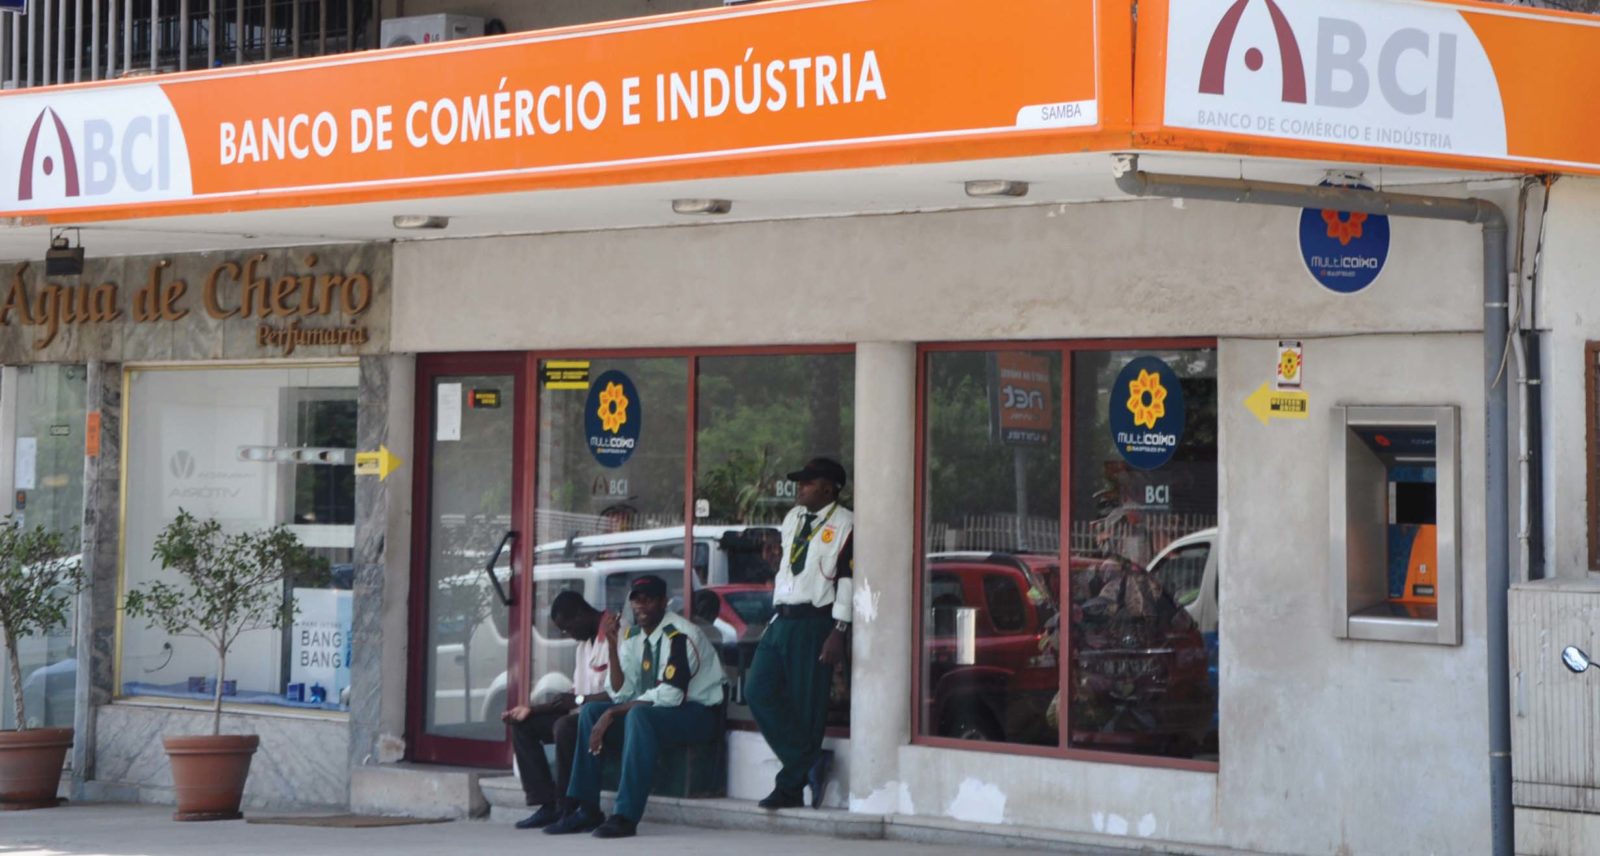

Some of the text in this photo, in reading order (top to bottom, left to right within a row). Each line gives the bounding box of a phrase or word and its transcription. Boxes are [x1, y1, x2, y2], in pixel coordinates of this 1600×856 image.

[219, 47, 887, 165] BANCO DE COMÉRCIO E INDÚSTRIA
[1040, 104, 1082, 121] SAMBA
[1197, 110, 1452, 149] BANCO DE COMÉRCIO E INDÚSTRIA
[132, 259, 190, 323] de
[203, 254, 373, 320] Cheiro
[256, 321, 368, 355] Perfumaria
[776, 480, 797, 497] BCI
[1145, 485, 1170, 503] BCI
[301, 630, 342, 648] BANG
[301, 650, 342, 669] BANG
